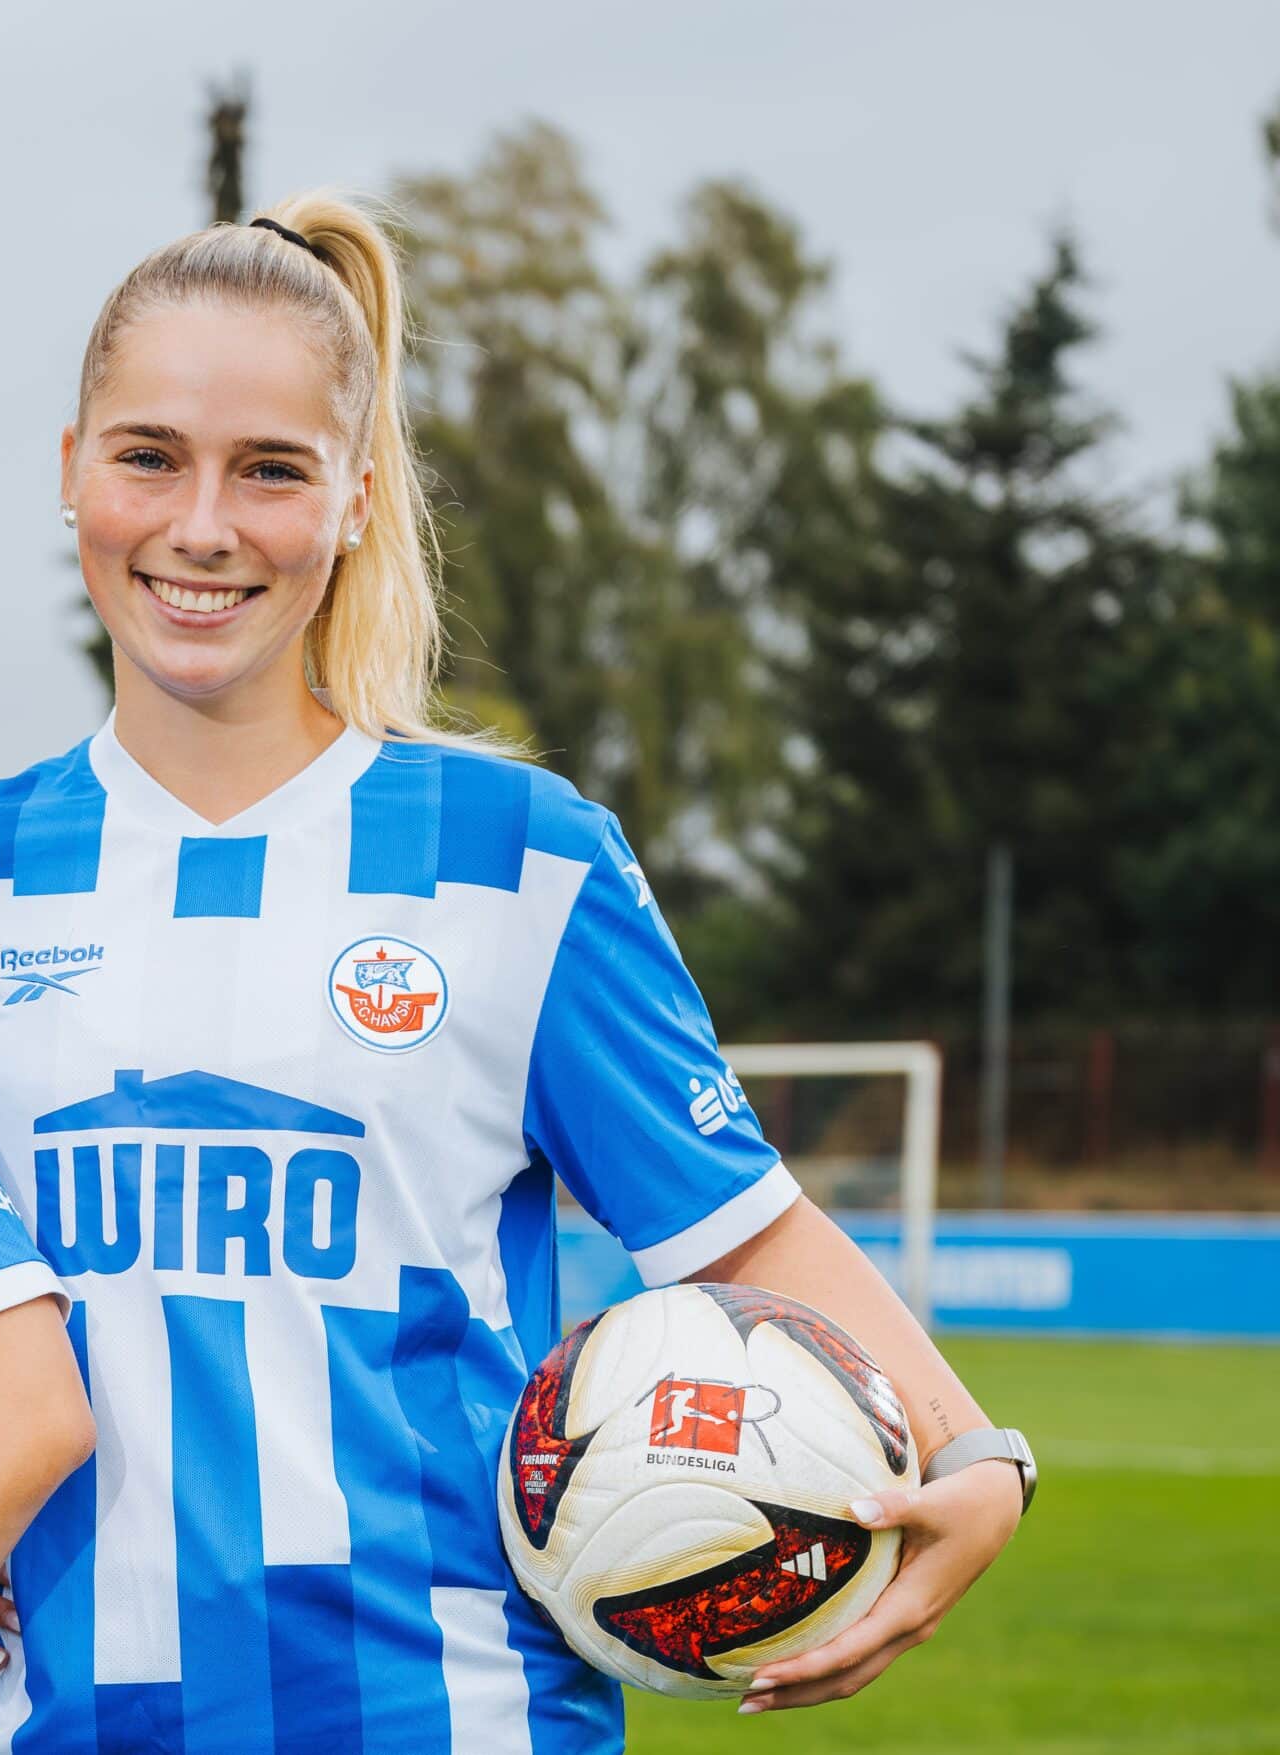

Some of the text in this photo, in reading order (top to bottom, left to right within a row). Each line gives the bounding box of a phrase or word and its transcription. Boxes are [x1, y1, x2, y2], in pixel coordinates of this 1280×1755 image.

[0, 944, 104, 971] Reebok
[33, 1143, 361, 1281] WIRO
[646, 1453, 737, 1473] BUNDESLIGA
